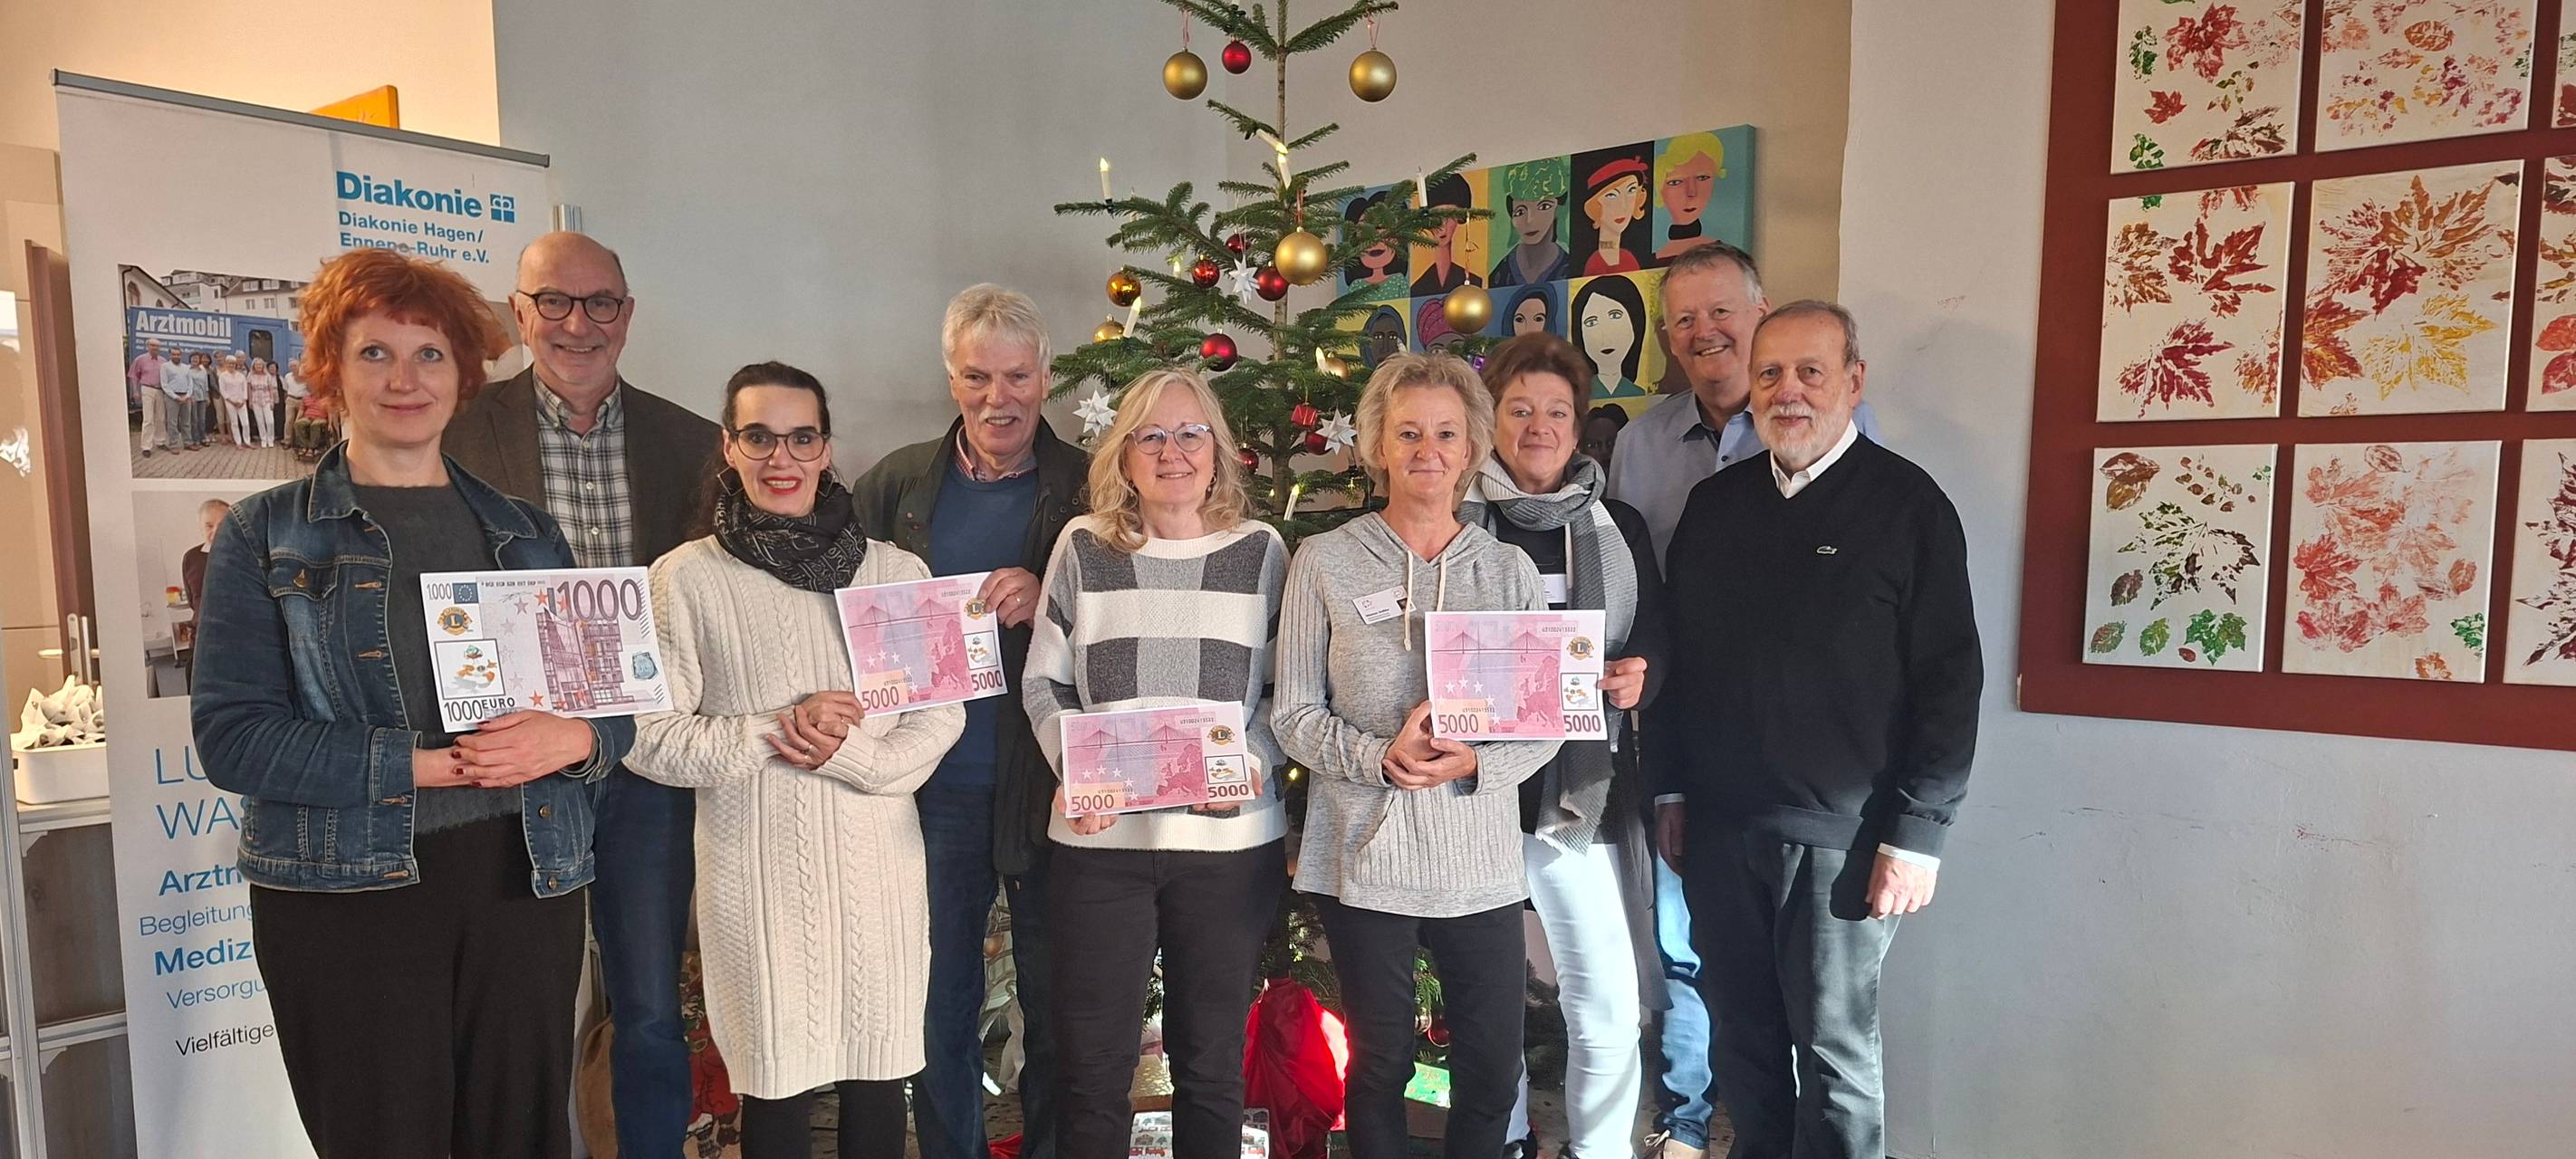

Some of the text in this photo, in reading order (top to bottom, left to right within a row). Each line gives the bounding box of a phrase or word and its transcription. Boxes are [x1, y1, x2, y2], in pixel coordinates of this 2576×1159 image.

[336, 170, 483, 218] Diakonie
[339, 211, 418, 234] Diakonie
[462, 248, 489, 263] e.V.
[136, 311, 232, 338] Arztmobil
[427, 583, 452, 600] 1000
[557, 579, 642, 622] 1000
[971, 670, 1003, 691] 5000
[444, 700, 483, 722] 1000
[481, 697, 515, 709] EURO
[861, 686, 899, 711] 5000
[1438, 714, 1479, 733] 5000
[1563, 714, 1601, 732] 5000
[1072, 794, 1114, 811] 5000
[1207, 784, 1249, 798] 5000
[156, 797, 247, 839] WA
[175, 1023, 274, 1057] Vielfältige
